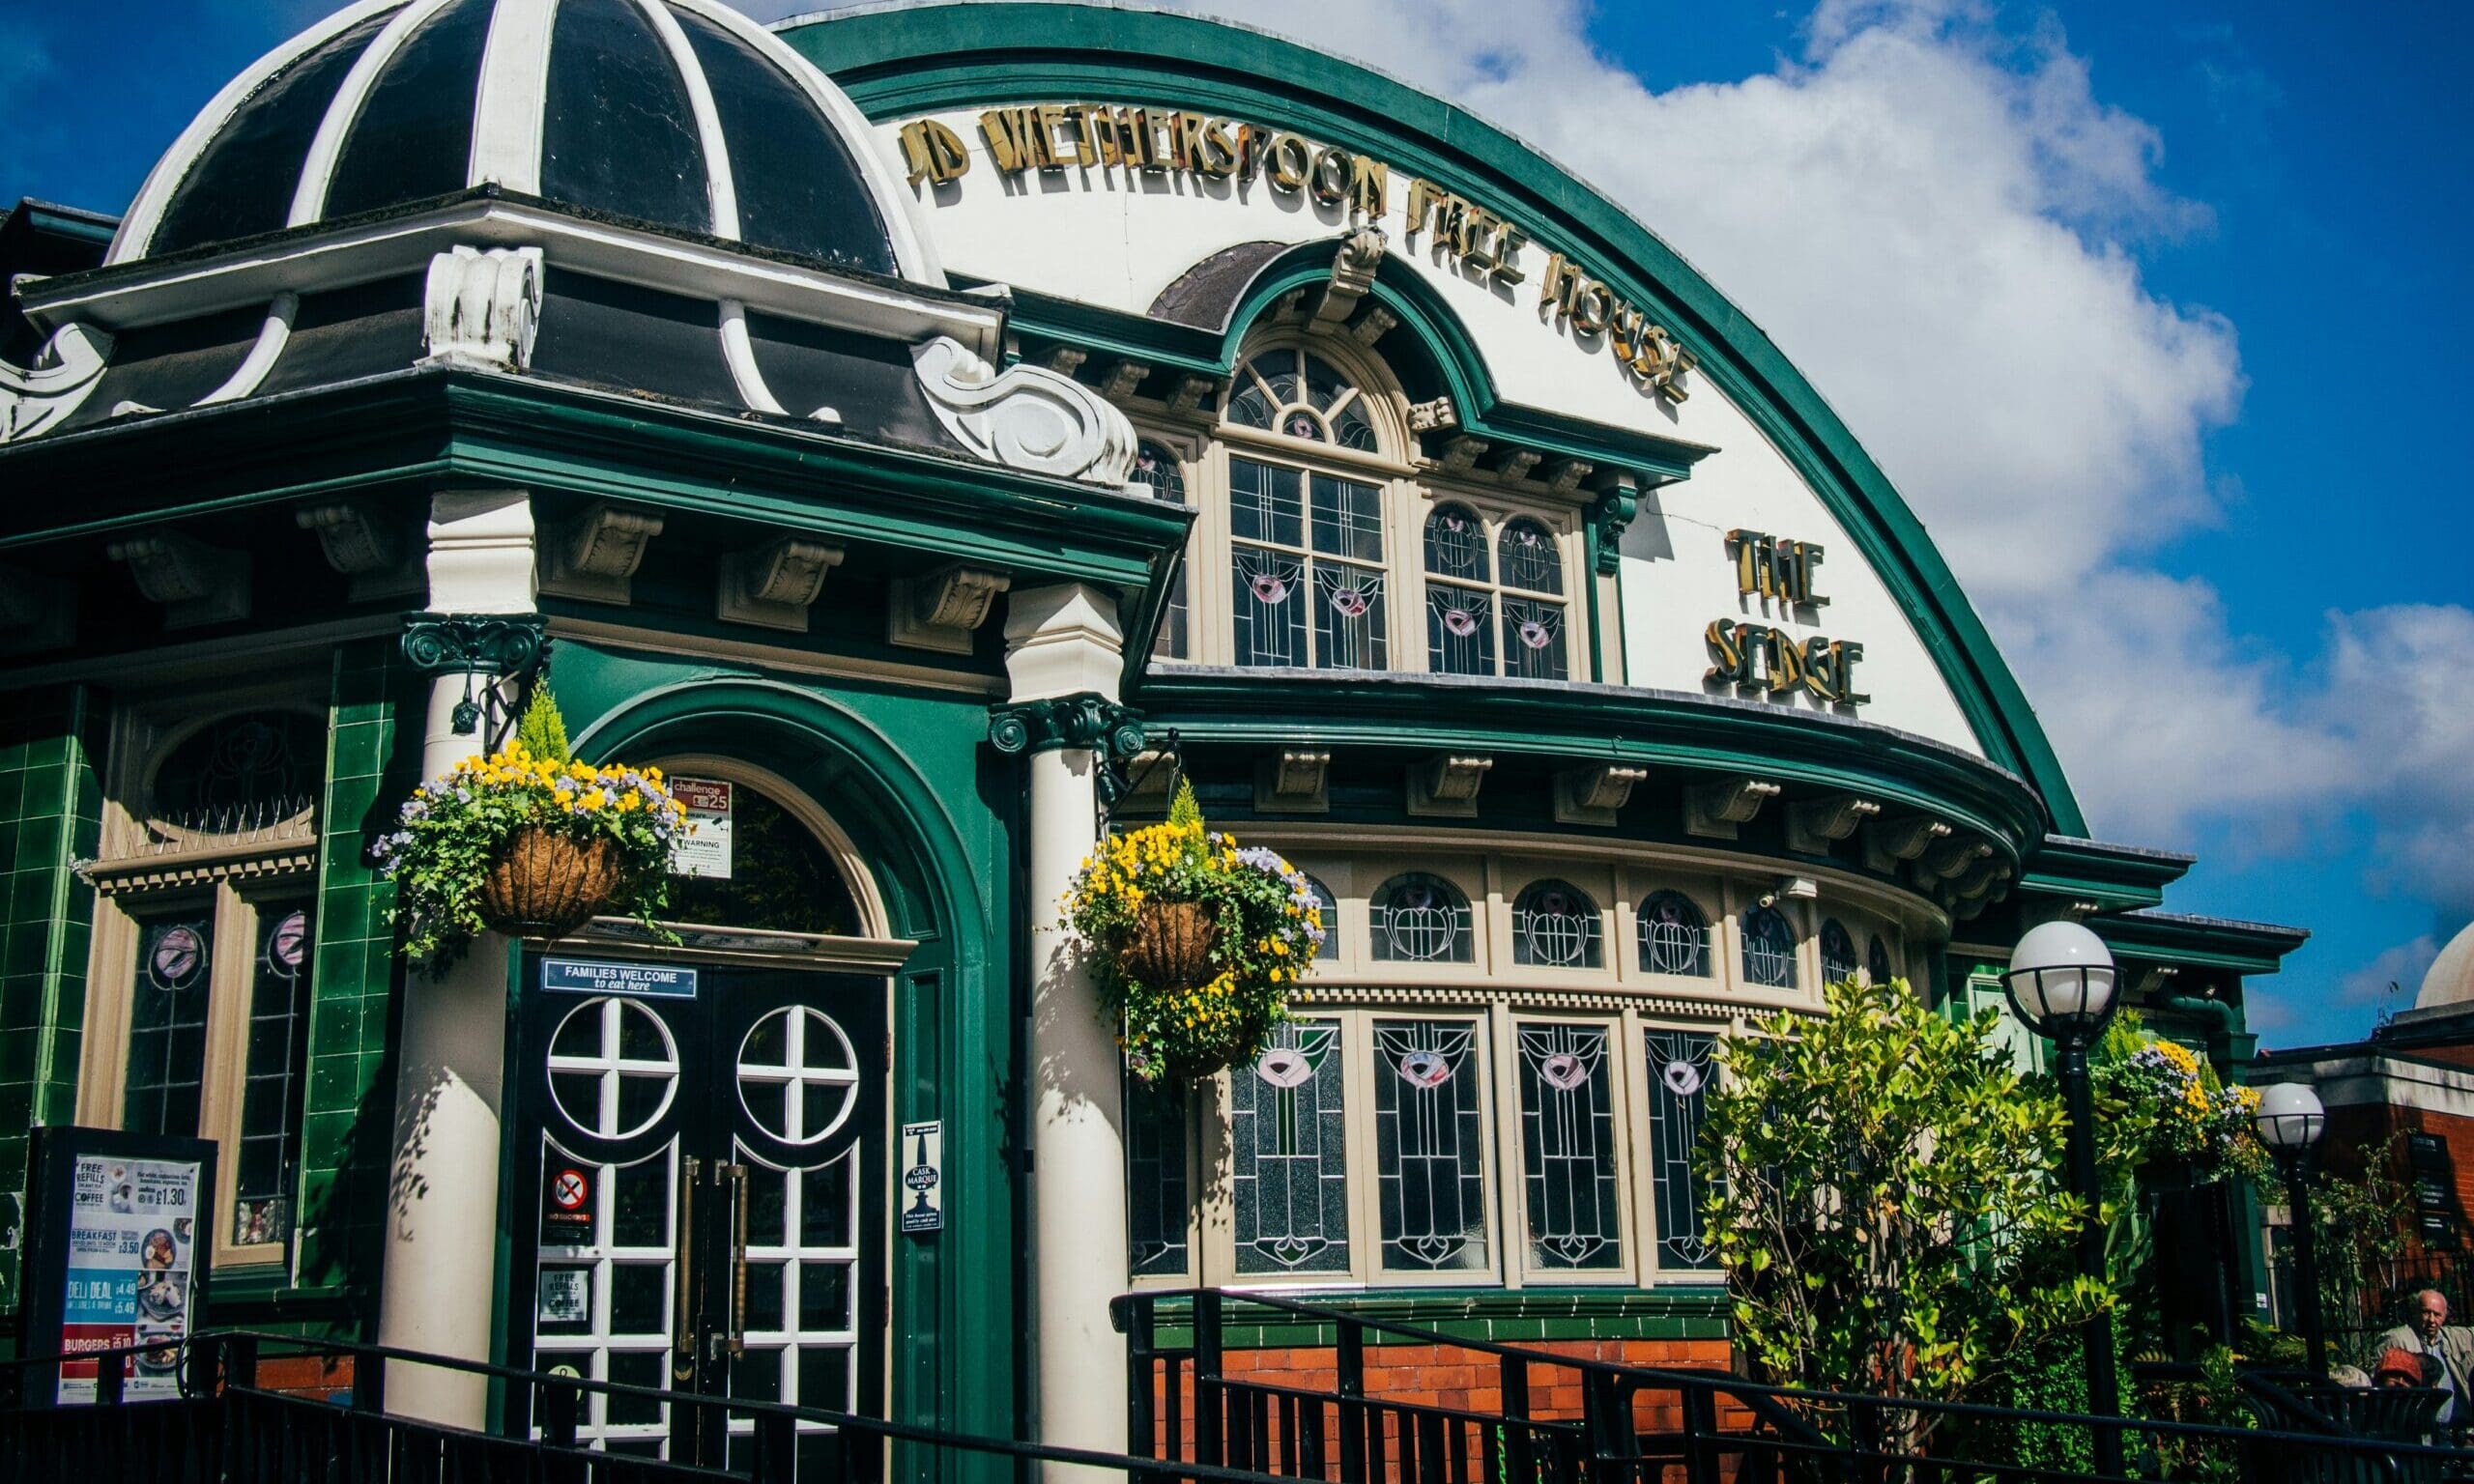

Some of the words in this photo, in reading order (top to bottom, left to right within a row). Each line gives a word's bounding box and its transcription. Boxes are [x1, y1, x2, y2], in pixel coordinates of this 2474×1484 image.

[898, 119, 968, 186] JD
[978, 104, 1388, 220] WETHERSPOON
[1406, 178, 1531, 286] FREE
[1541, 252, 1699, 405] HOUSE
[1725, 528, 1831, 610] THE
[1703, 617, 1872, 706] SEDGE
[675, 782, 721, 796] challenge
[709, 795, 728, 810] 25
[684, 839, 720, 849] WARNING
[564, 966, 618, 979] FAMILIES
[619, 970, 677, 984] WELCOME
[594, 978, 606, 989] to
[608, 979, 625, 990] eat
[627, 980, 650, 991] here
[81, 1163, 103, 1174] FREE
[912, 1167, 932, 1176] CASK
[76, 1173, 105, 1184] REFILLS
[907, 1175, 937, 1184] MARQUE
[75, 1192, 104, 1204] COFFEE
[156, 1187, 185, 1206] £1.30
[72, 1230, 117, 1241] BREAKFAST
[69, 1281, 88, 1299] DELI
[90, 1281, 113, 1299] DEAL
[64, 1338, 110, 1353] BURGERS
